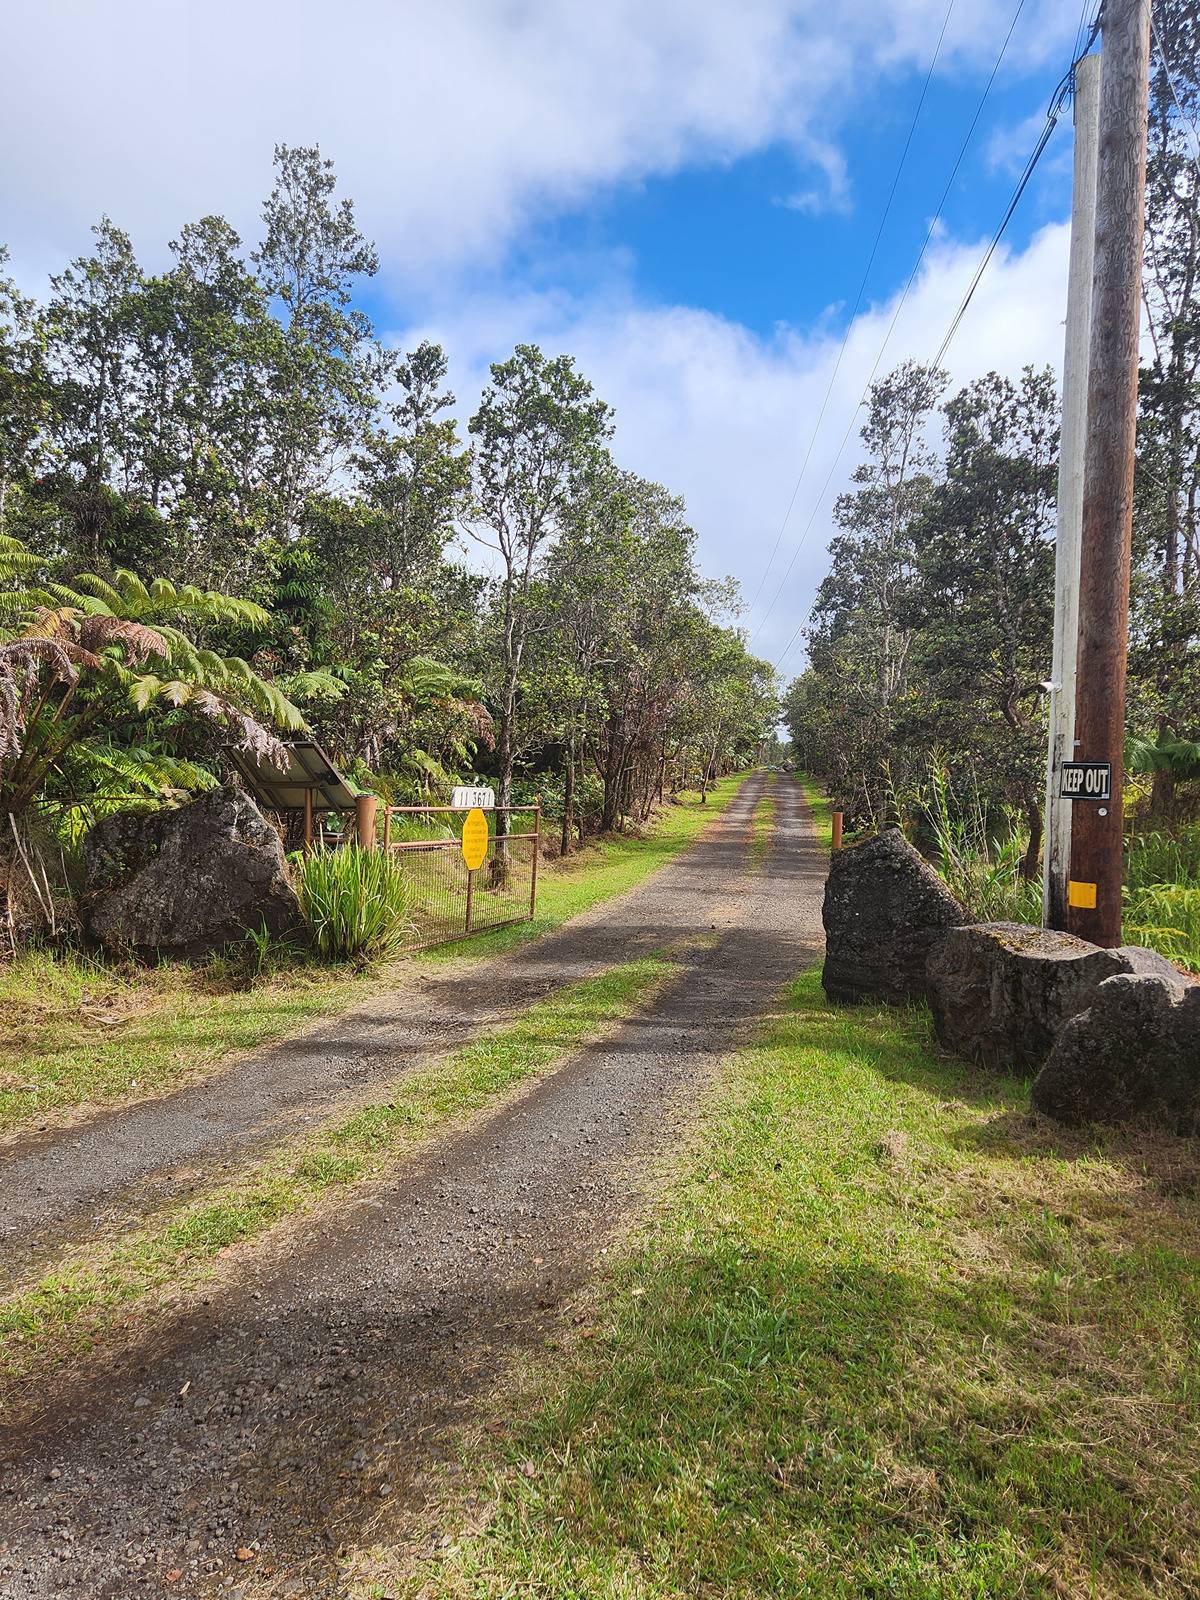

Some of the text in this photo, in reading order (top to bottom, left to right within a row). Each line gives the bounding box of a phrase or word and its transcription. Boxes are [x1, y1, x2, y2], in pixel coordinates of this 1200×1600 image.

[1062, 768, 1108, 793] KEEP OUT
[460, 791, 469, 806] 11
